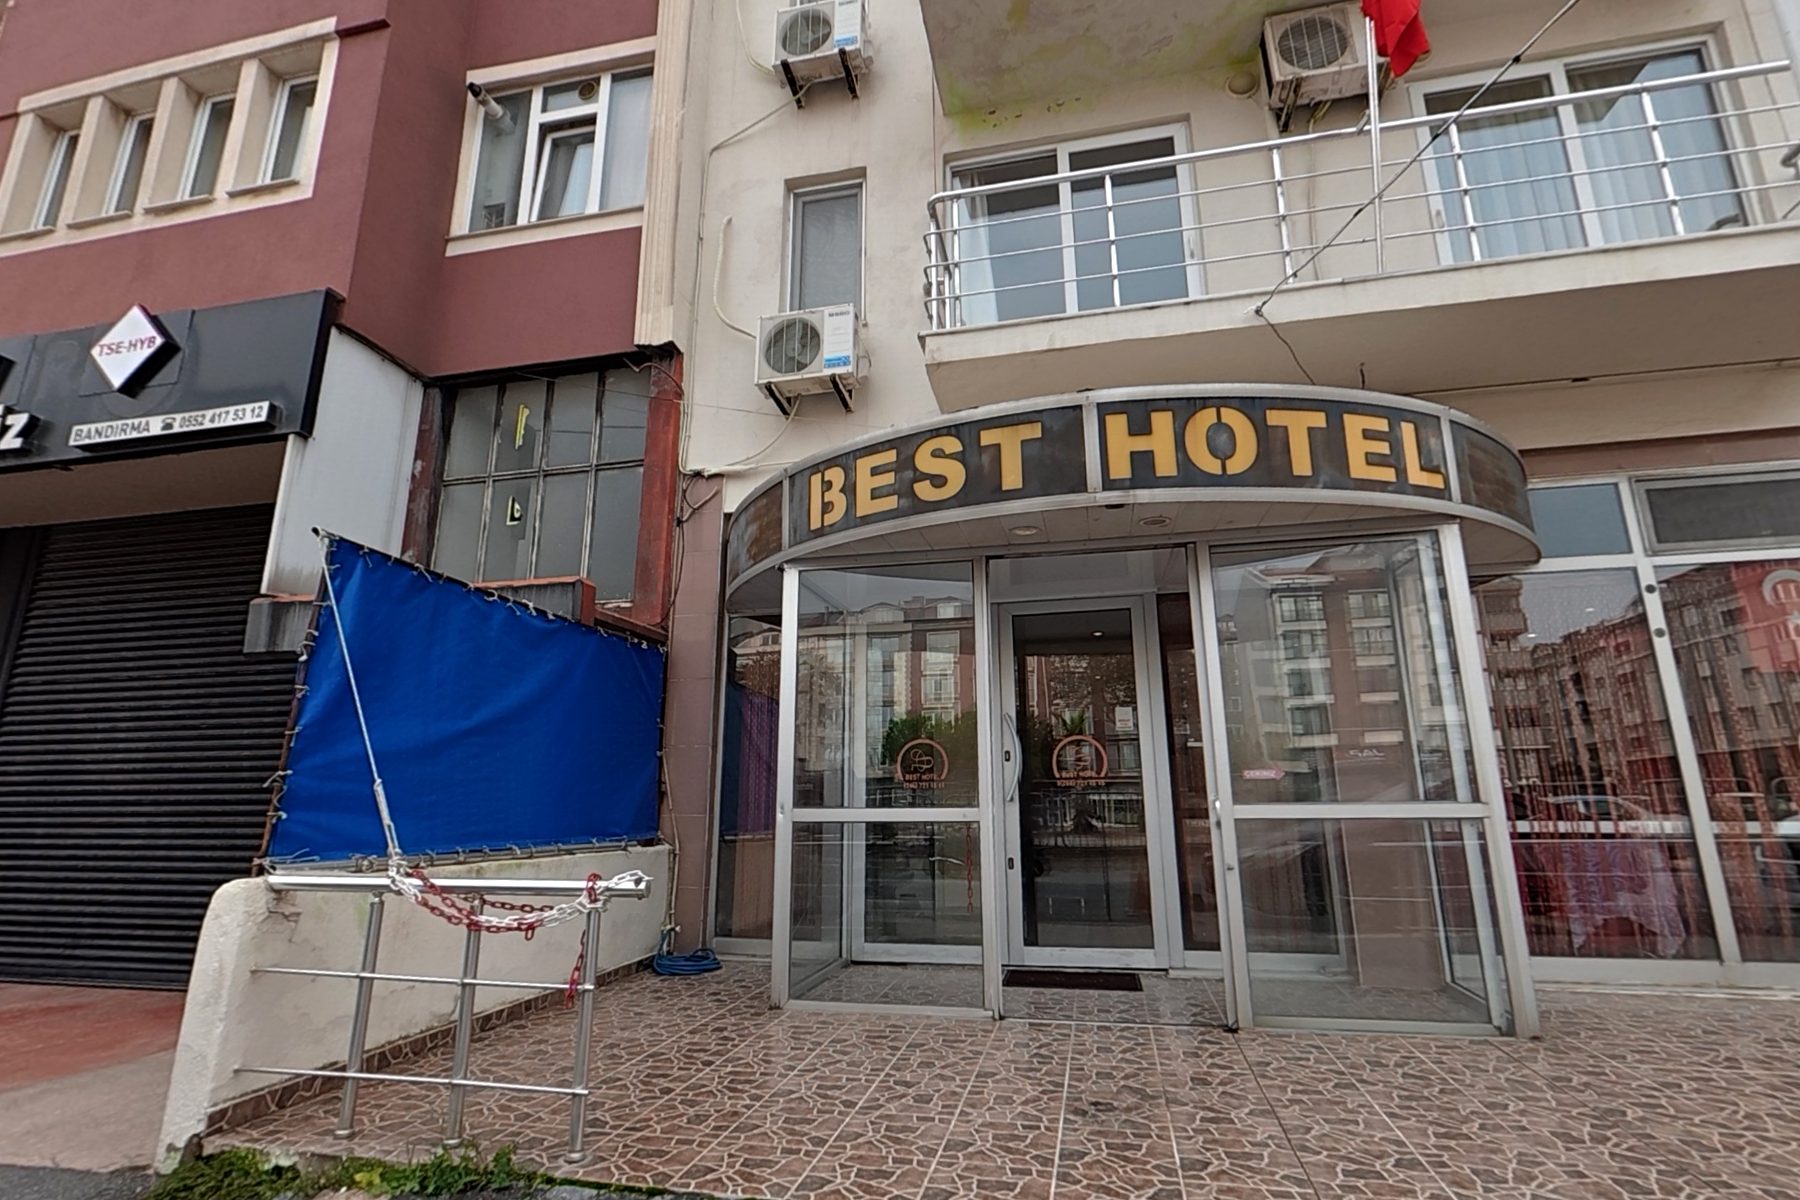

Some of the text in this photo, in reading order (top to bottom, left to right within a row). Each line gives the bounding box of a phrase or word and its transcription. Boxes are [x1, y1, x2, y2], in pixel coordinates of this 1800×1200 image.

[98, 336, 157, 357] TSE-HYB
[72, 405, 264, 443] BANDIRMA 0552 417 53 12
[809, 406, 1446, 531] BEST HOTEL
